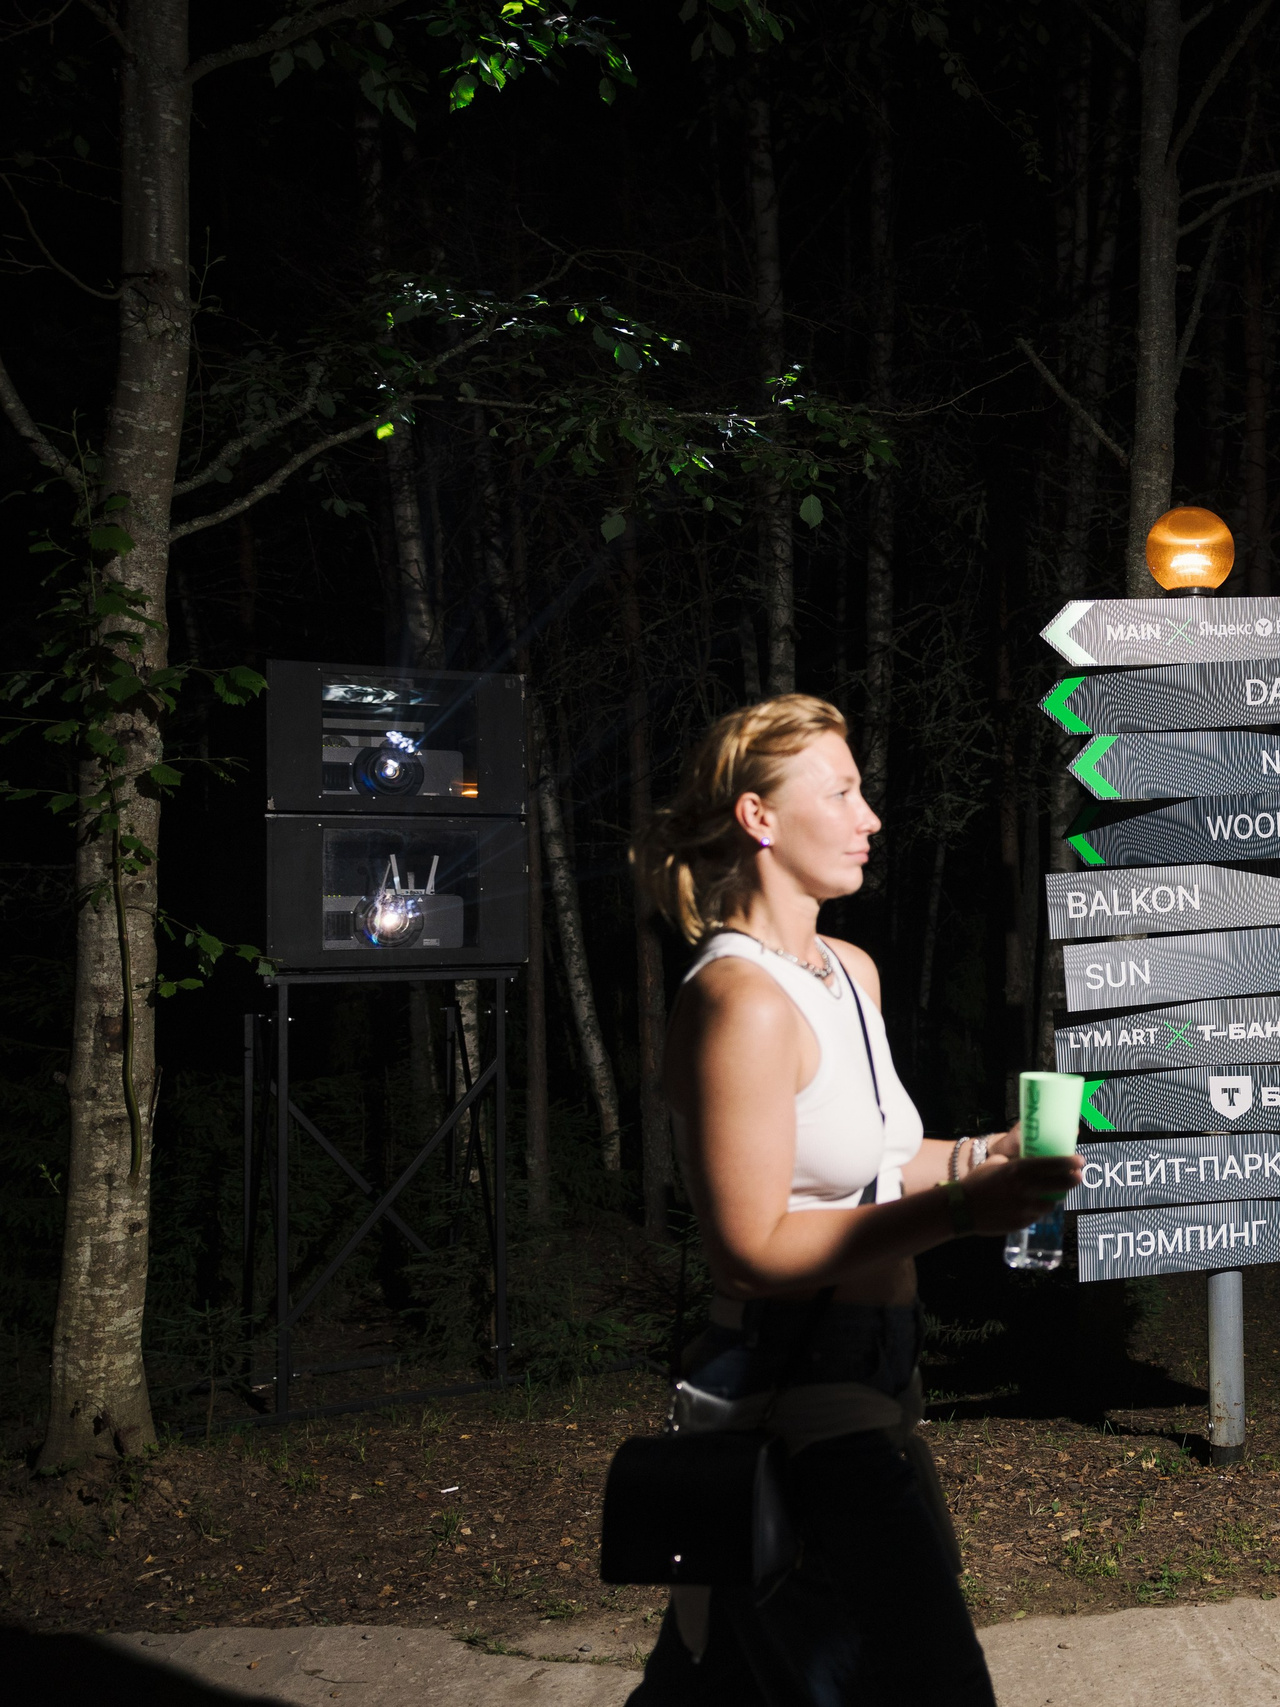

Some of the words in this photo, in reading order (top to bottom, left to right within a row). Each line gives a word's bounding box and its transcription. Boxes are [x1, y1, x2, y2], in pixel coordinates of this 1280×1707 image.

[1106, 622, 1162, 641] MAIN
[1199, 621, 1253, 637] Яндекс
[1067, 884, 1201, 919] BALKON
[1085, 959, 1151, 990] SUN
[1069, 1030, 1112, 1049] LYM
[1117, 1027, 1159, 1046] ART
[1098, 1219, 1268, 1260] ГЛЭМПИНГ
